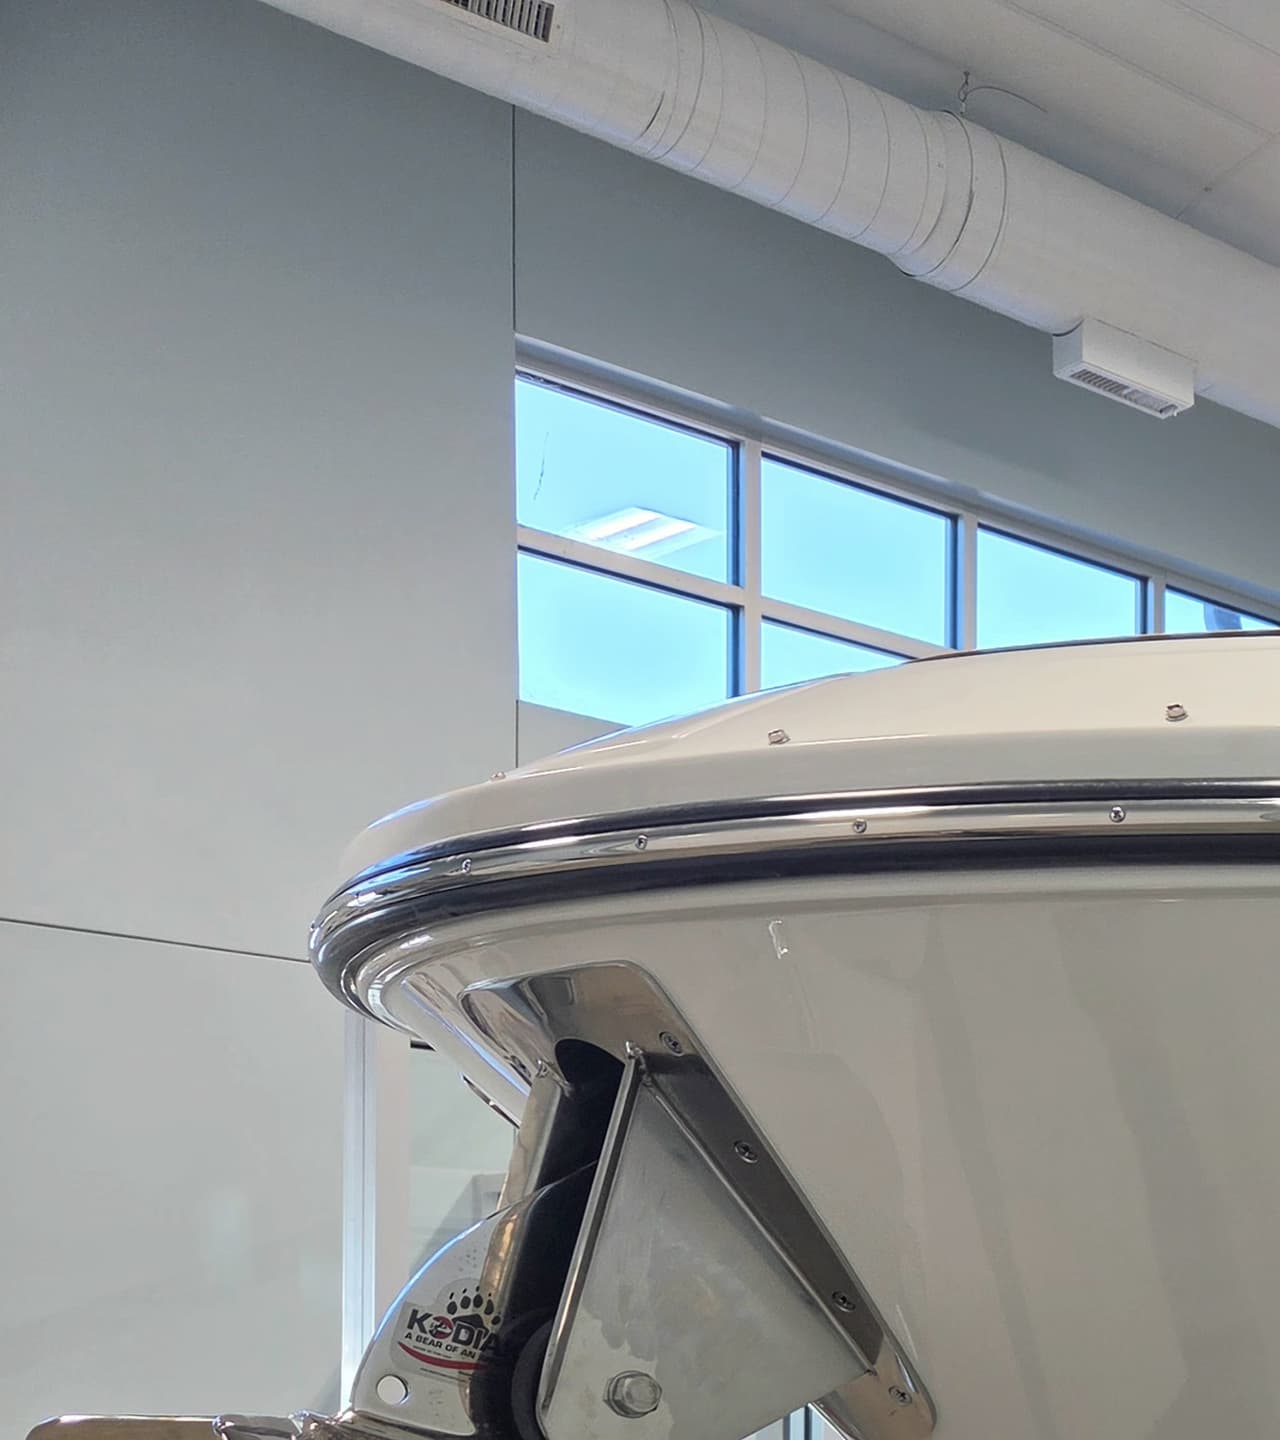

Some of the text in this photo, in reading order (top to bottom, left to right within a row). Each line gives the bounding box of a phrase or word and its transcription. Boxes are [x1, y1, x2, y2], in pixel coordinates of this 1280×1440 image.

[404, 1332, 412, 1340] A
[416, 1334, 443, 1349] BEAR
[445, 1344, 458, 1353] OF
[460, 1349, 477, 1360] AN
